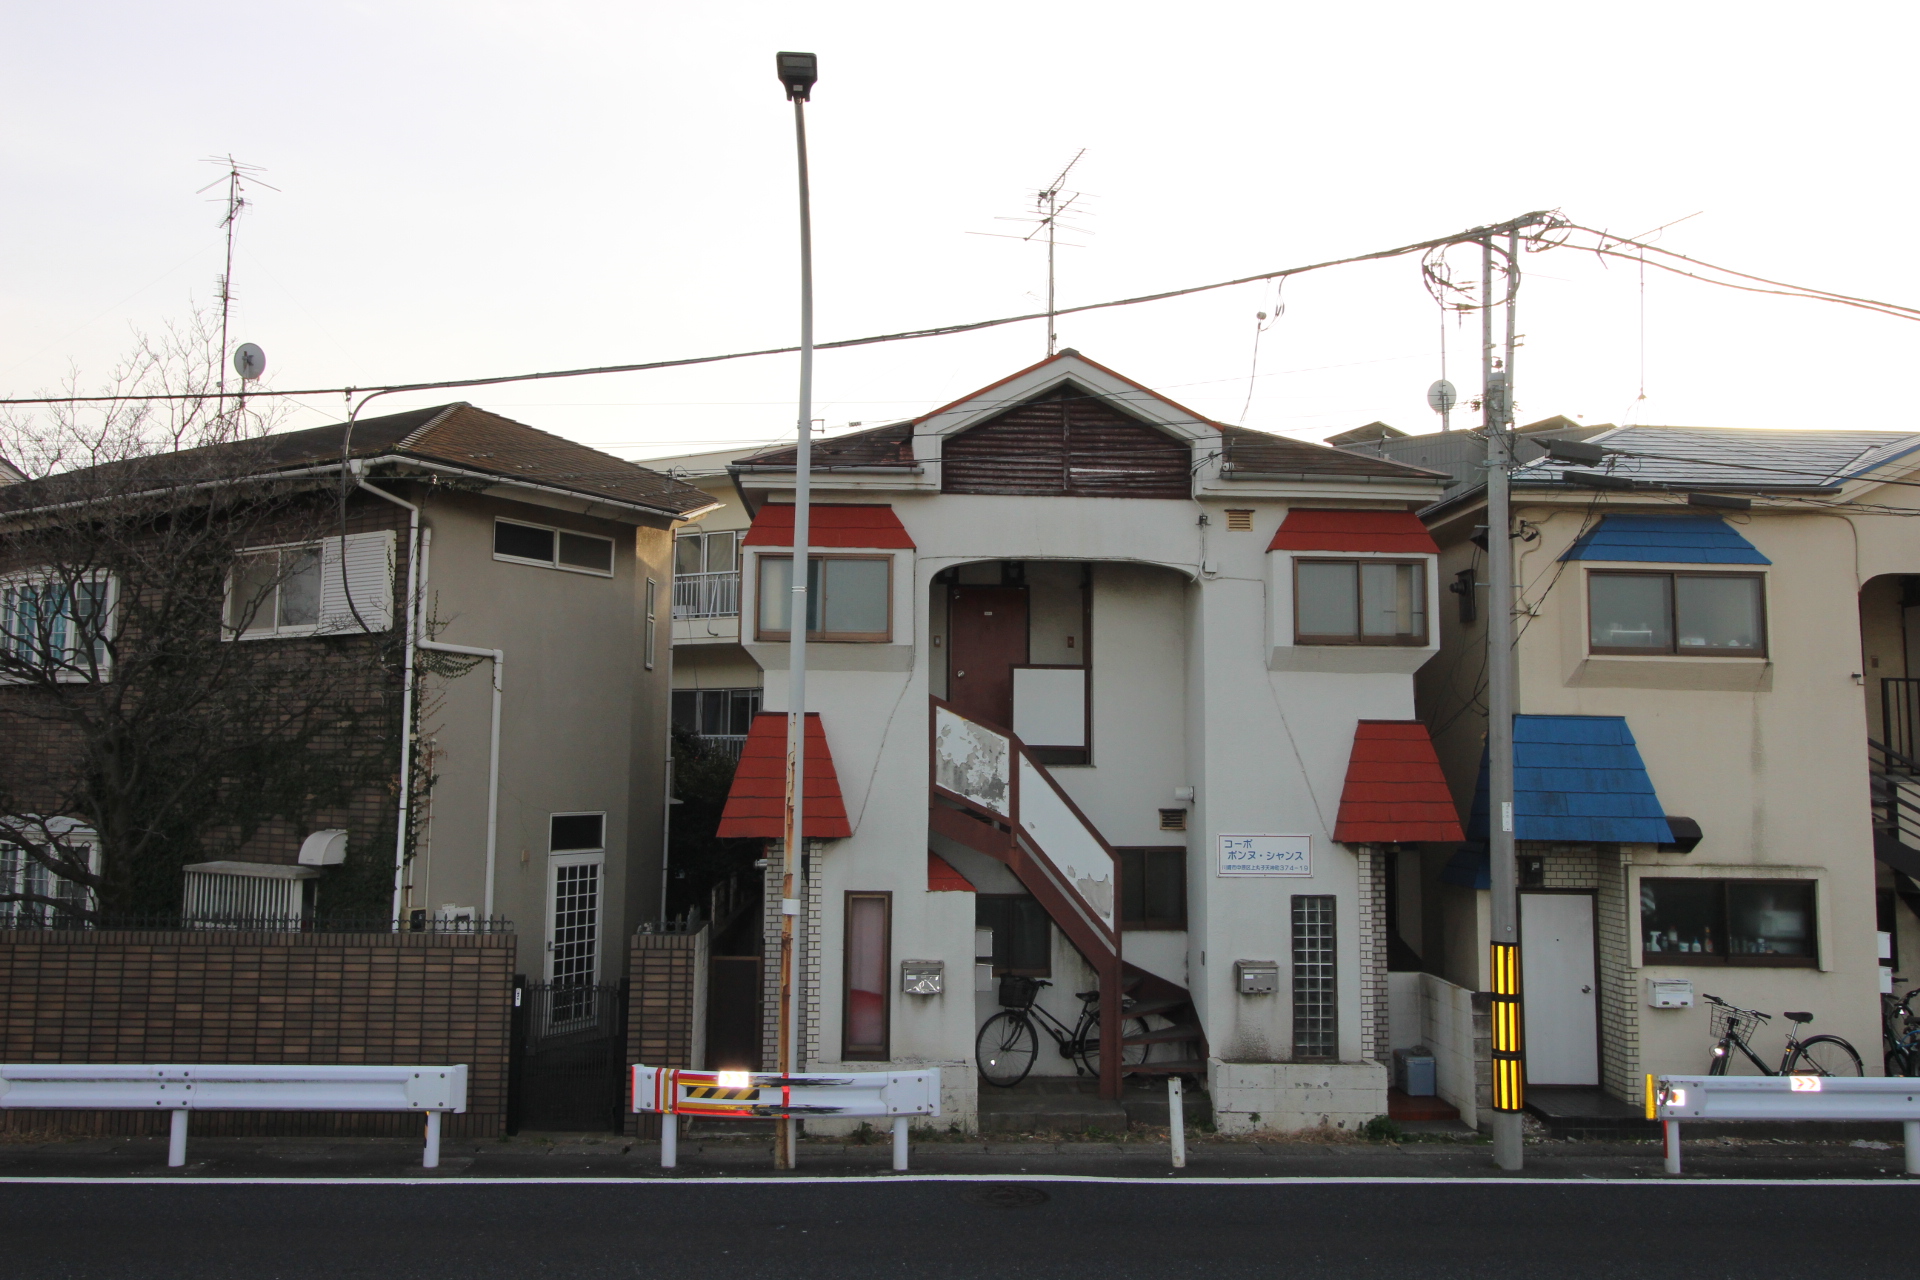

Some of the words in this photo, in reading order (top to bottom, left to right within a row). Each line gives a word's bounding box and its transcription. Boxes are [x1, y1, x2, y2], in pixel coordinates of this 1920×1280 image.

[1224, 839, 1253, 849] コーポ
[1227, 850, 1304, 861] ボンヌ・シャンス
